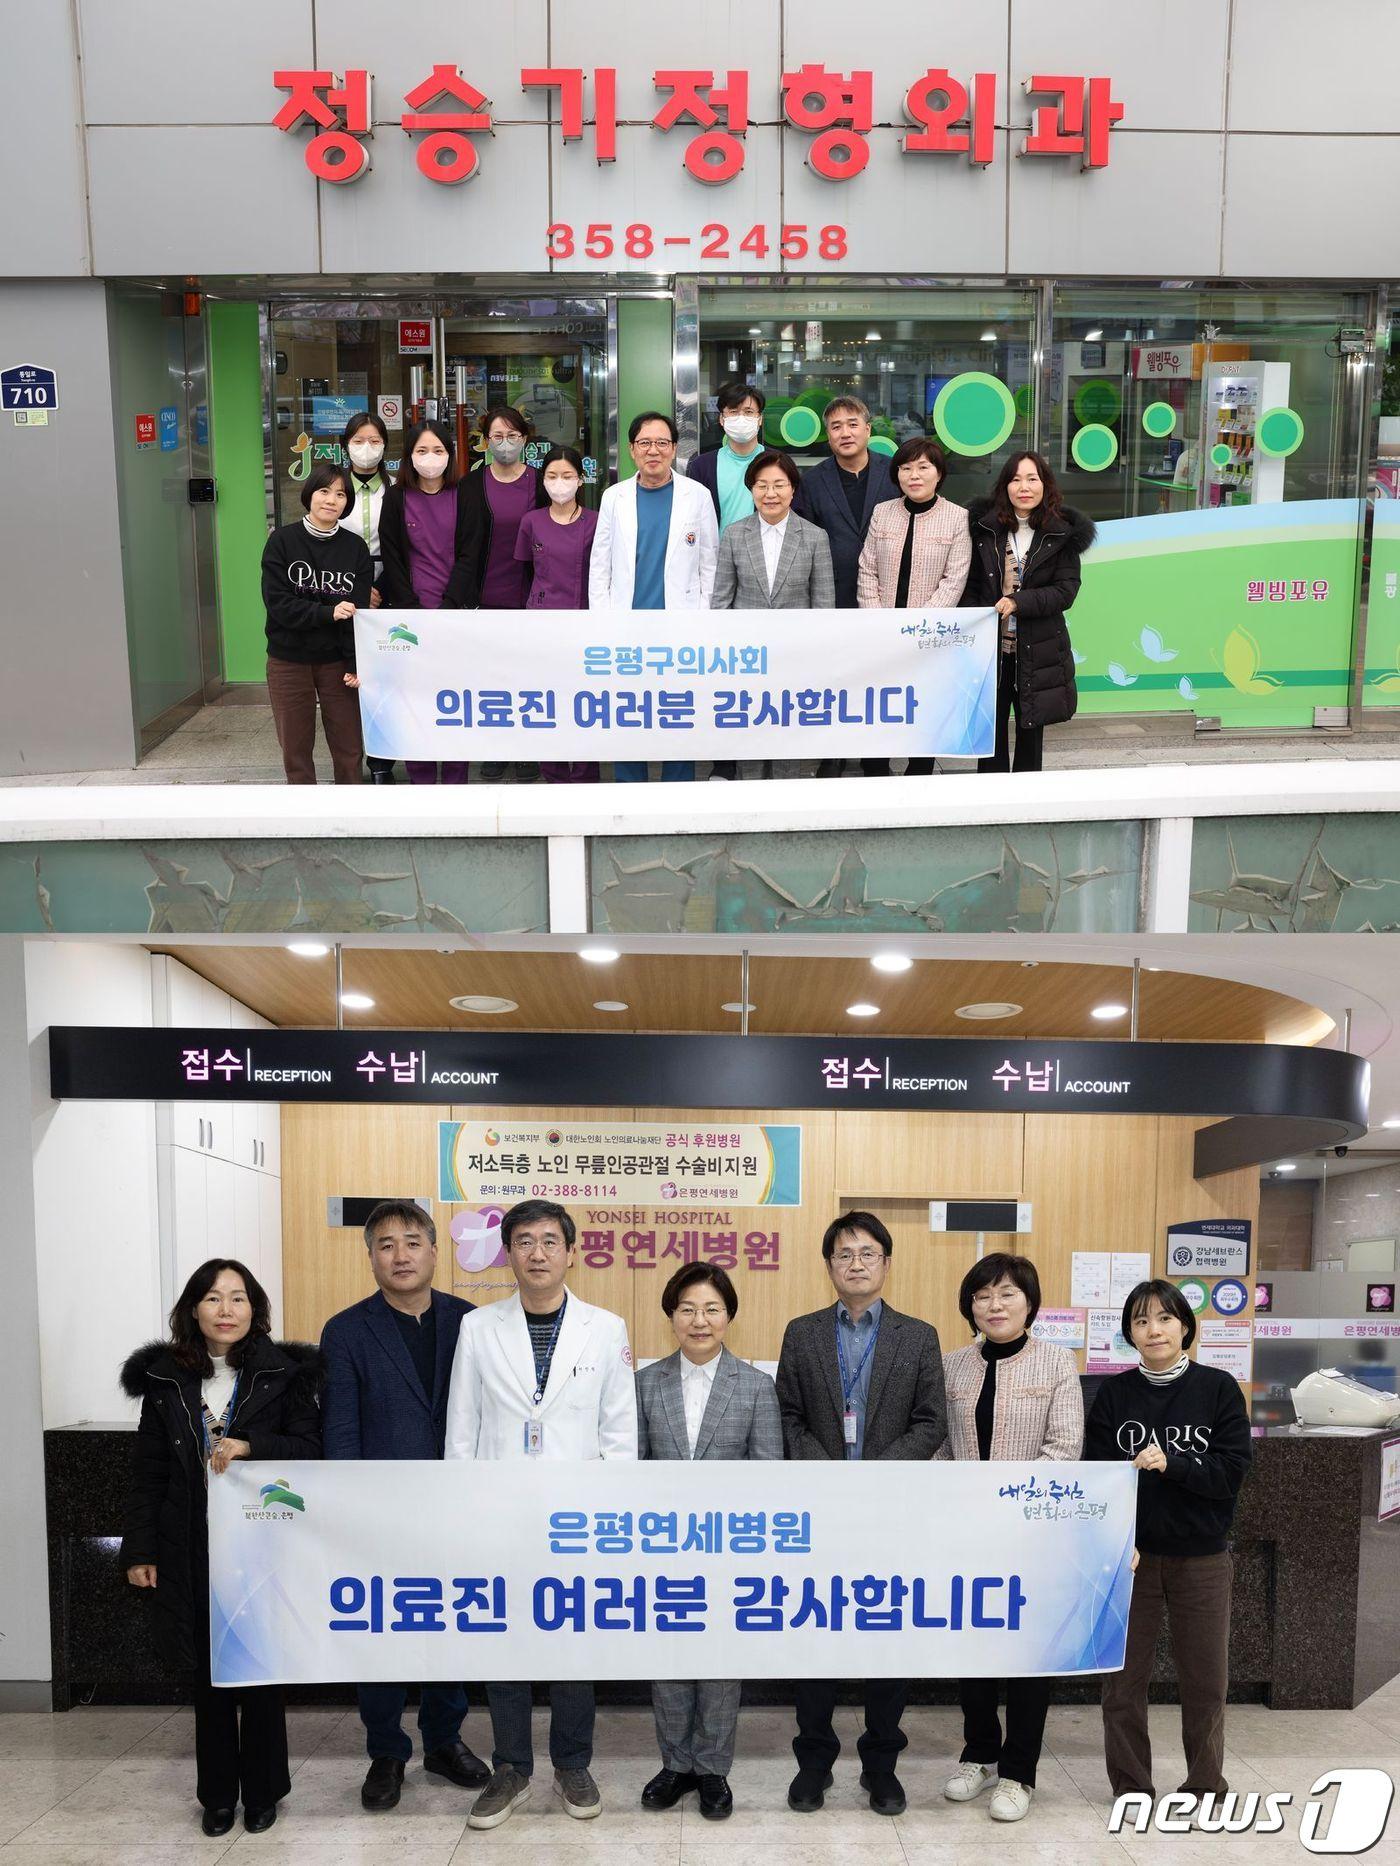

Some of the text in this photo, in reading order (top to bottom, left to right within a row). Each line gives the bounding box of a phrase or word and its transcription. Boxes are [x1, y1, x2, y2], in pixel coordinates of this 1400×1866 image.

[546, 223, 848, 260] 358-2458
[404, 329, 426, 338] 에스원
[1146, 350, 1183, 374] 웰빙포유
[20, 370, 37, 379] 통일로
[10, 387, 48, 404] 710
[287, 560, 356, 593] PARIS
[1247, 580, 1329, 603] 웰빙포유
[583, 645, 769, 676] 은평구의사회
[435, 685, 919, 729] 의료진 여러분 감사합니다
[181, 1048, 243, 1081] 접수
[254, 1069, 332, 1082] RECEPTION
[356, 1051, 419, 1083] 수납
[821, 1057, 882, 1089] 접수
[992, 1060, 1054, 1092] 수납
[431, 1072, 500, 1084] ACCOUNT
[892, 1078, 968, 1091] RECEPTION
[1064, 1081, 1131, 1093] ACCOUNT
[503, 1133, 540, 1143] 보건복지부
[565, 1134, 602, 1144] 대한노인회
[665, 1133, 689, 1148] 공식
[692, 1133, 741, 1148] 후원병원
[468, 1153, 531, 1174] 저소득층
[537, 1154, 568, 1174] 노인
[575, 1155, 669, 1176] 무릎인공관절
[531, 1184, 617, 1197] 02-388-8114
[679, 1187, 739, 1199] 은평연세병원
[586, 1210, 733, 1225] YONSEI HOSPITAL
[568, 1230, 780, 1271] 평연세병원
[1195, 1246, 1243, 1256] 강남세브란스
[1195, 1257, 1228, 1267] 협력병원
[1116, 1420, 1212, 1456] PARIS
[547, 1510, 812, 1555] 은평연세병원
[328, 1573, 1027, 1634] 의료진 여러분 감사합니다
